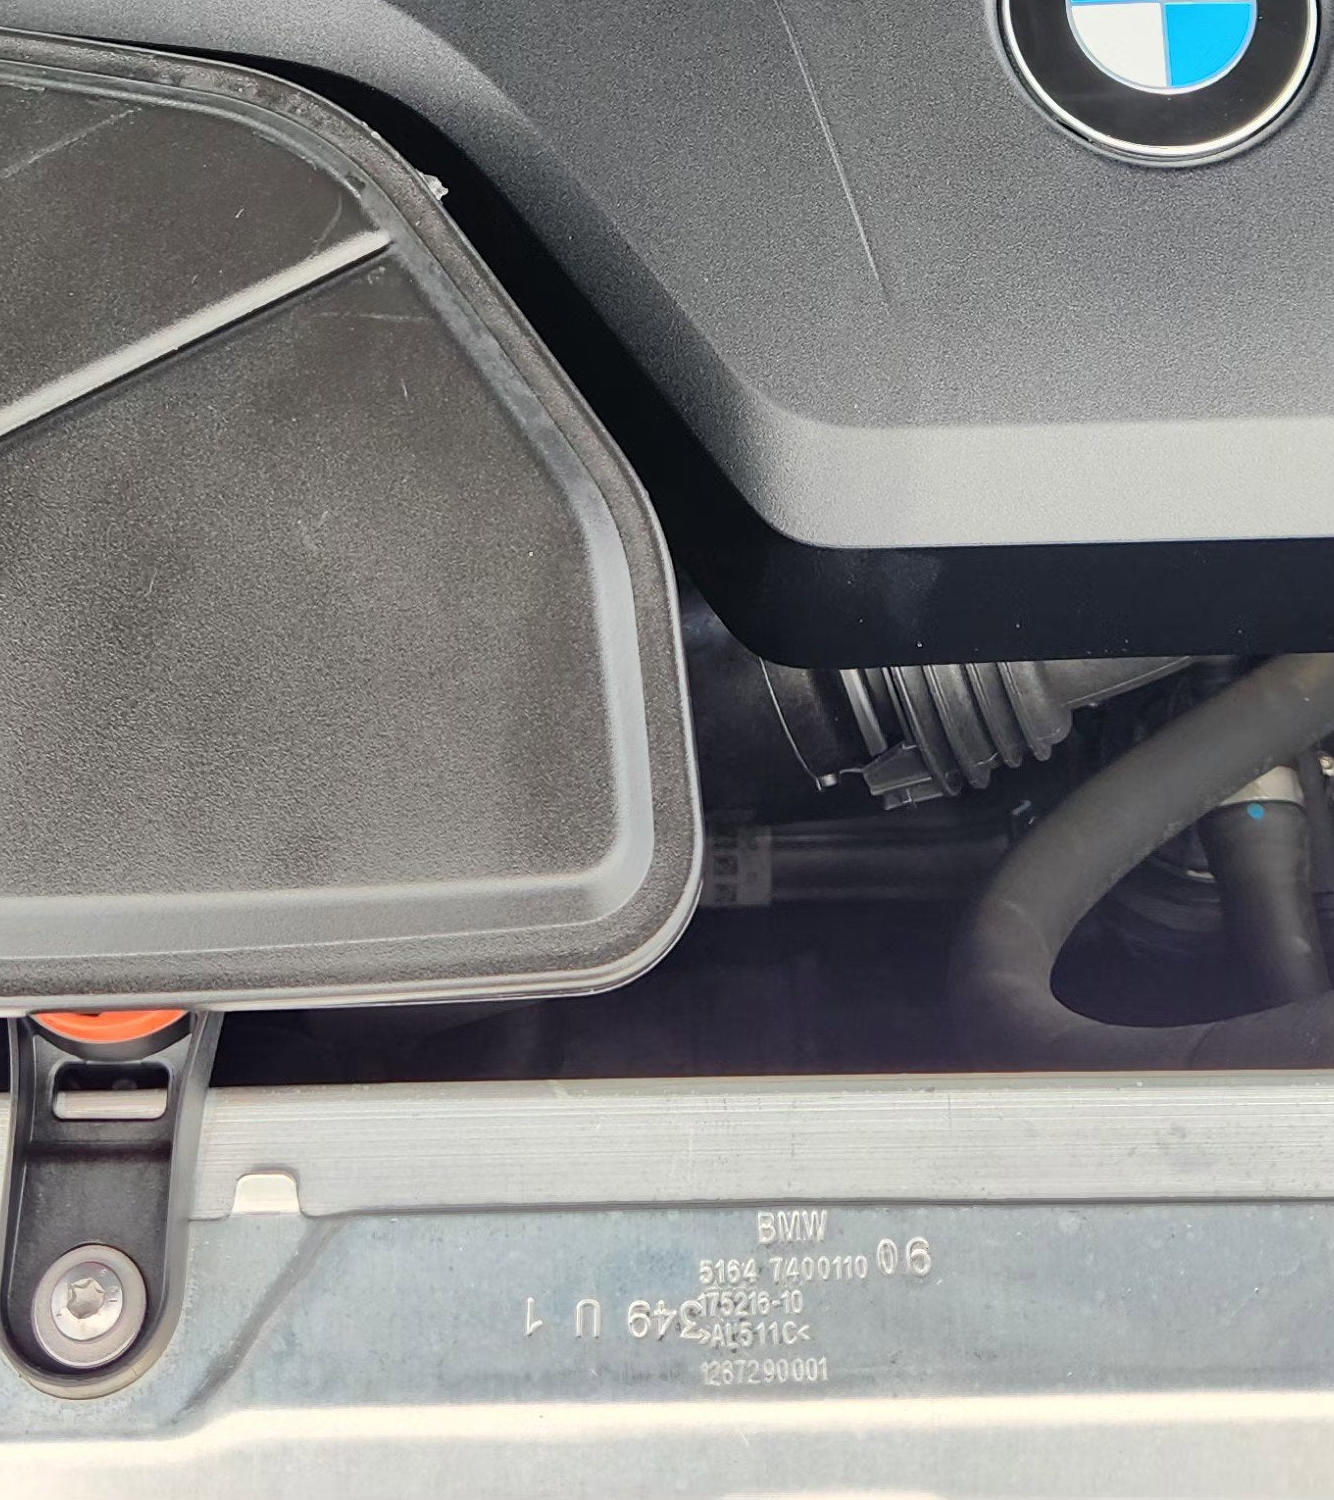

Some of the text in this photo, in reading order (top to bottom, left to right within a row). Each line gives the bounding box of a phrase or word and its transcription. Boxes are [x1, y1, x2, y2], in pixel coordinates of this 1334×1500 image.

[757, 1209, 828, 1245] BMW
[698, 1255, 868, 1285] 5164 7400110
